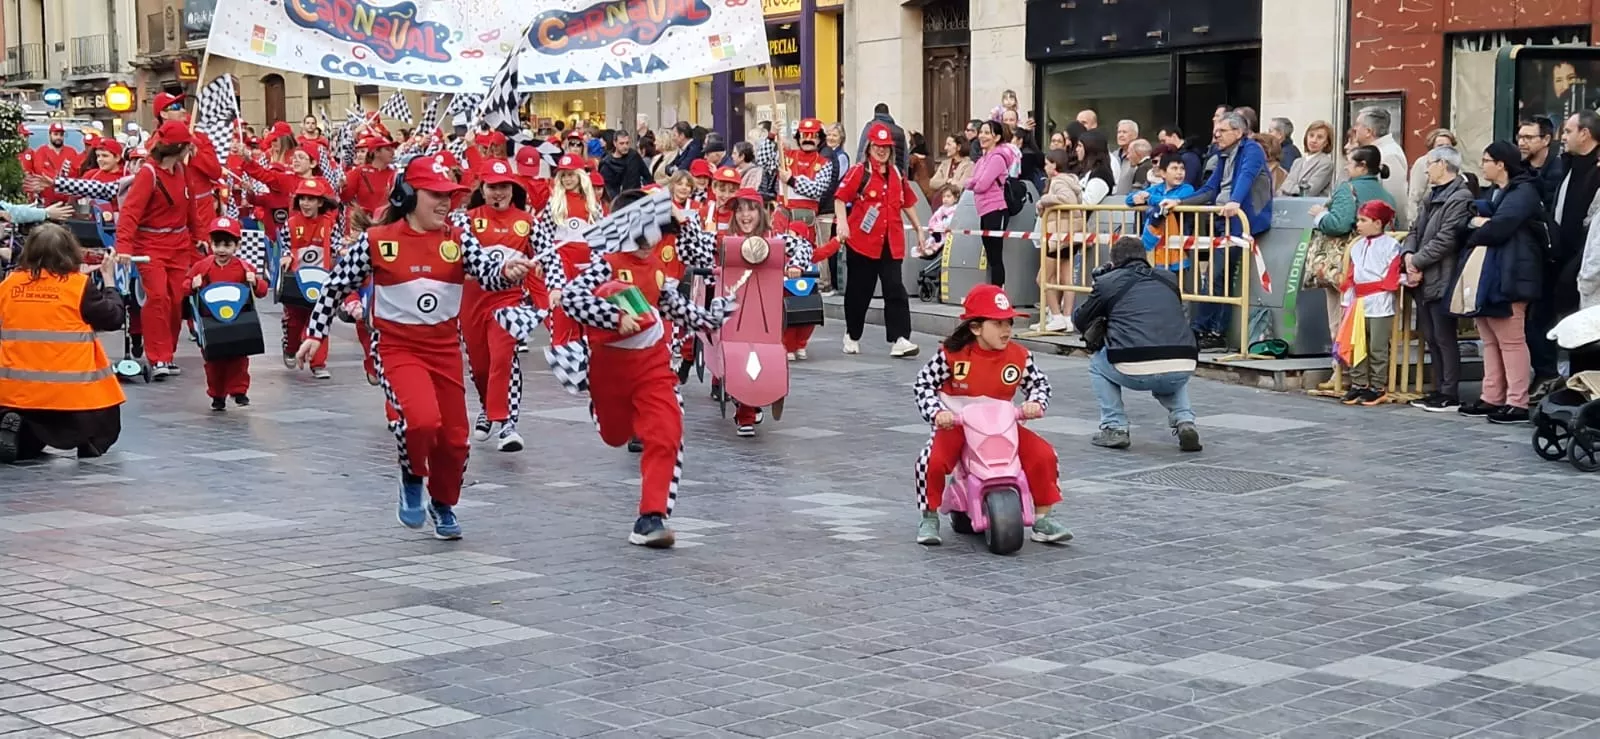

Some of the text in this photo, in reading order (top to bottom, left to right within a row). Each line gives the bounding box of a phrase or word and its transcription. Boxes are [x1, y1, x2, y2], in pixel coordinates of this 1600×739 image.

[768, 37, 798, 56] PECIAL
[321, 53, 670, 87] COLEGIO SNTA ANA
[380, 242, 396, 257] 1
[1287, 241, 1307, 294] VIDRIO
[955, 362, 966, 376] 1
